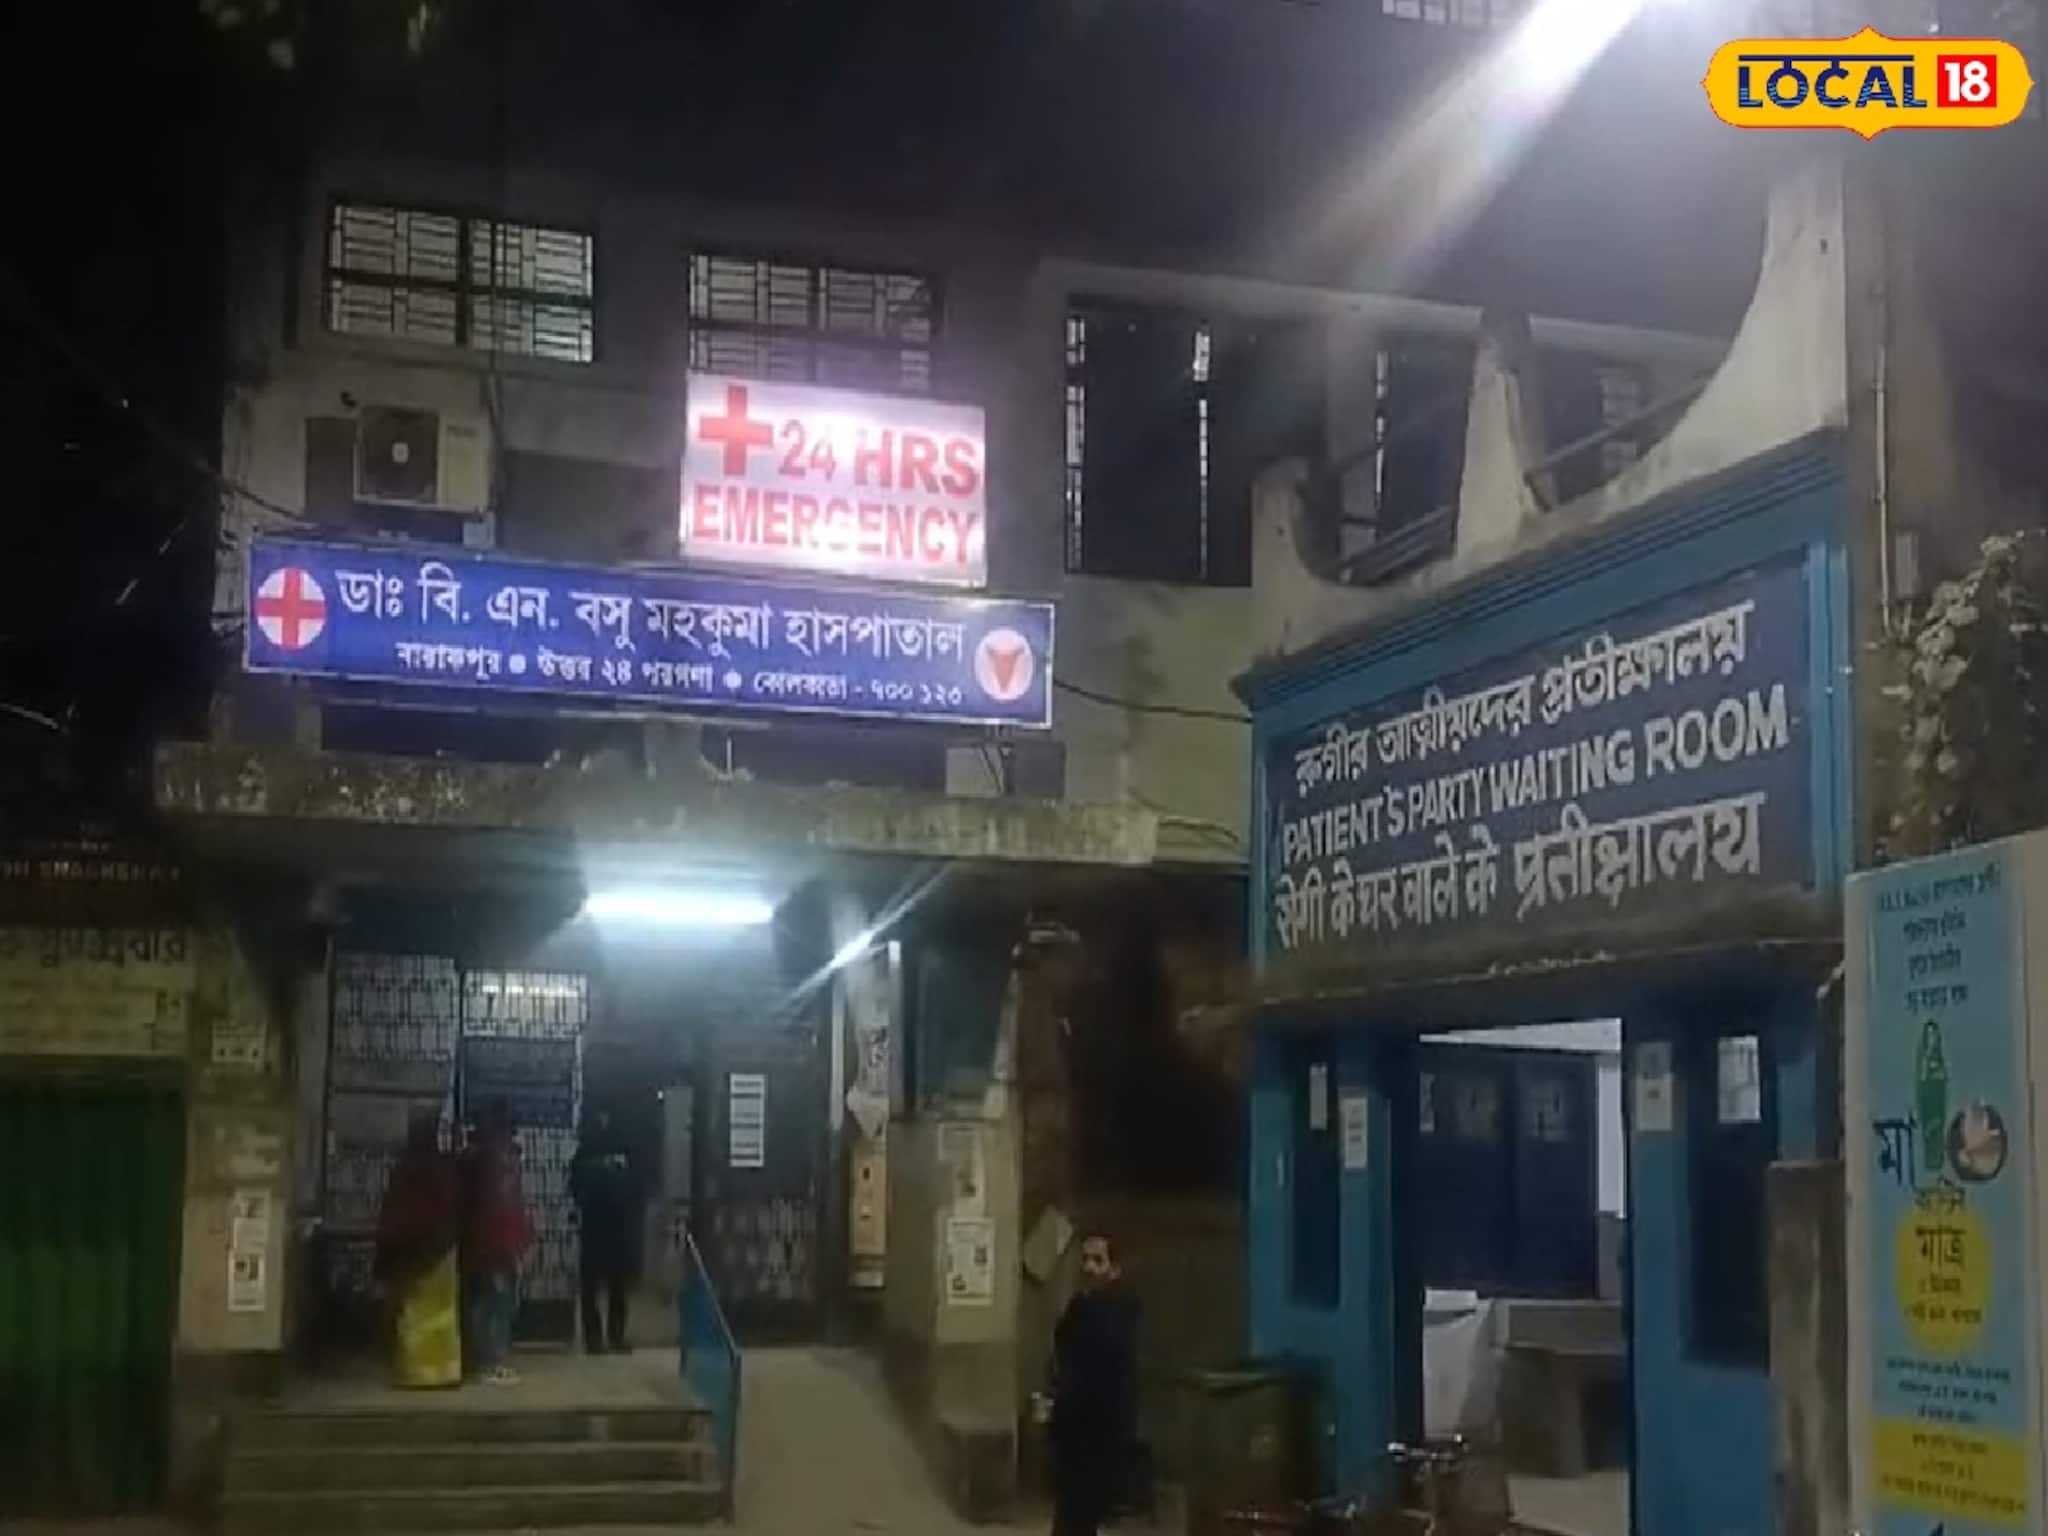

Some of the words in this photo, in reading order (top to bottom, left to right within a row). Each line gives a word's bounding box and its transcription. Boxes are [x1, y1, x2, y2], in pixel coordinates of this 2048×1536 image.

[778, 419, 836, 480] 24
[854, 429, 980, 497] HRS
[692, 484, 977, 564] EMERGENCY
[334, 569, 403, 619] ডাঃ
[568, 591, 636, 651] বসু
[644, 598, 773, 659] মহকুমা
[783, 606, 967, 662] হাসপাতাল
[602, 659, 632, 686] ২৪
[1282, 785, 1405, 866] PATIENT'S
[1408, 766, 1484, 833] PARTY
[1488, 729, 1635, 808] WAITING
[1644, 684, 1789, 779] ROOM
